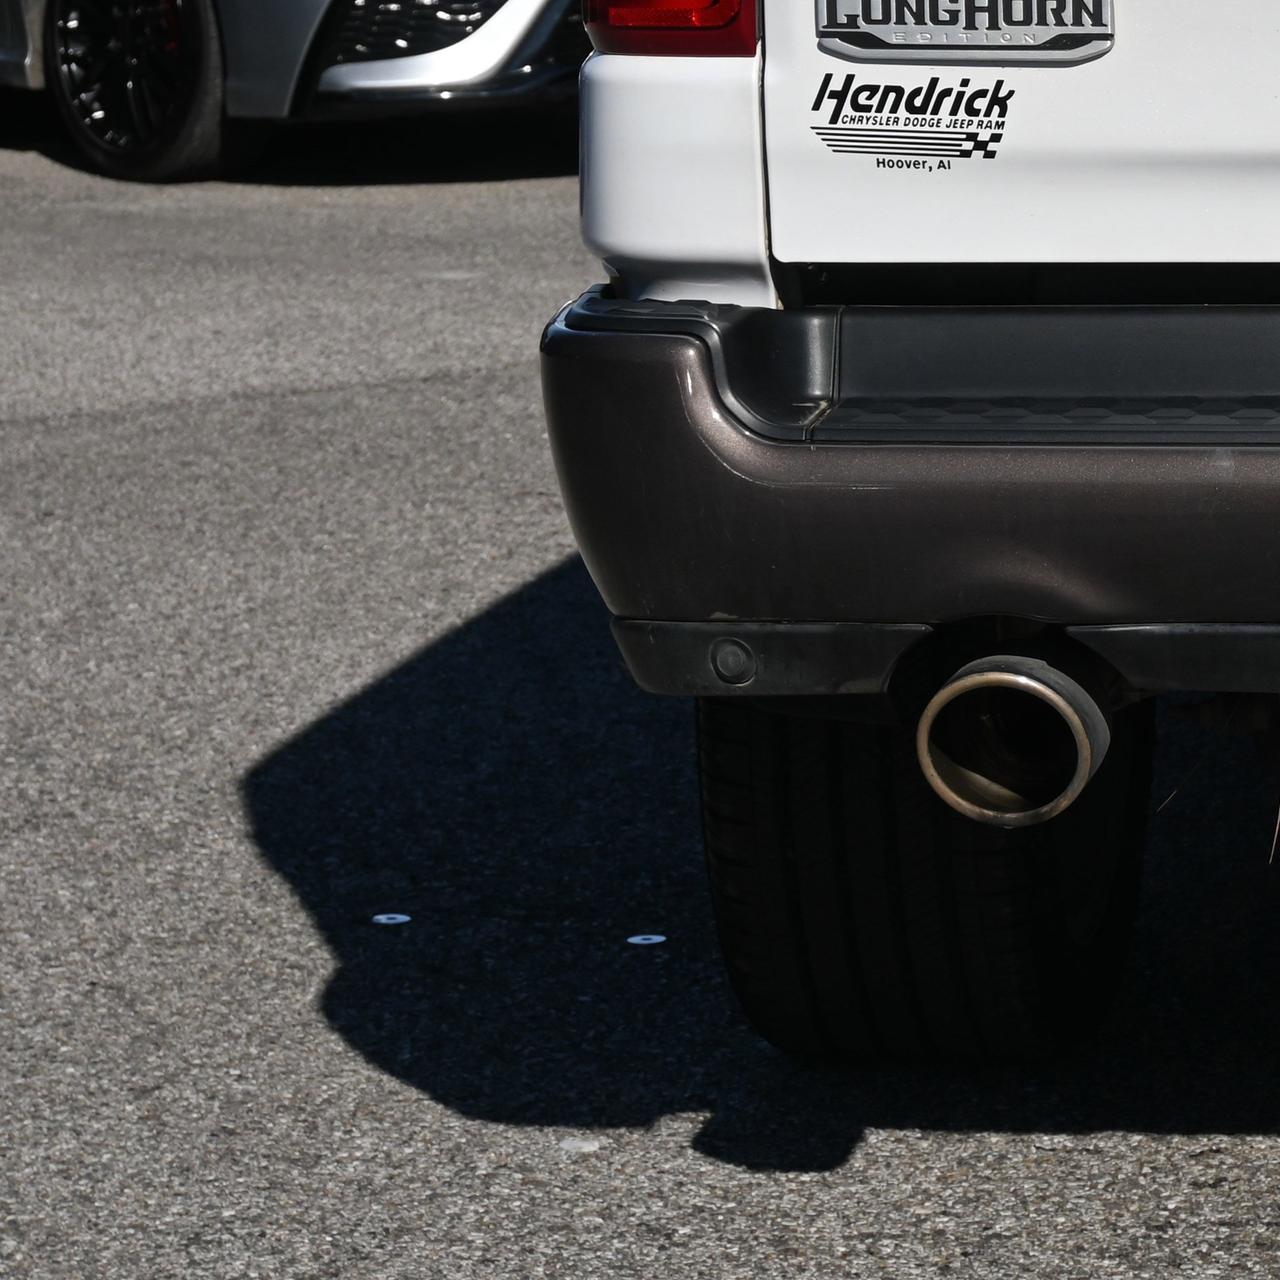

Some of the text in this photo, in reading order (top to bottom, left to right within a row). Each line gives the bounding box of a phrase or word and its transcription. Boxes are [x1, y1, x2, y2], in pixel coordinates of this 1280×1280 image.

[891, 32, 1036, 44] EDITION
[811, 73, 1015, 124] Hendrick
[841, 114, 1005, 130] CHRYSLER DODGE JEEP RAM
[876, 158, 933, 172] Hoover,
